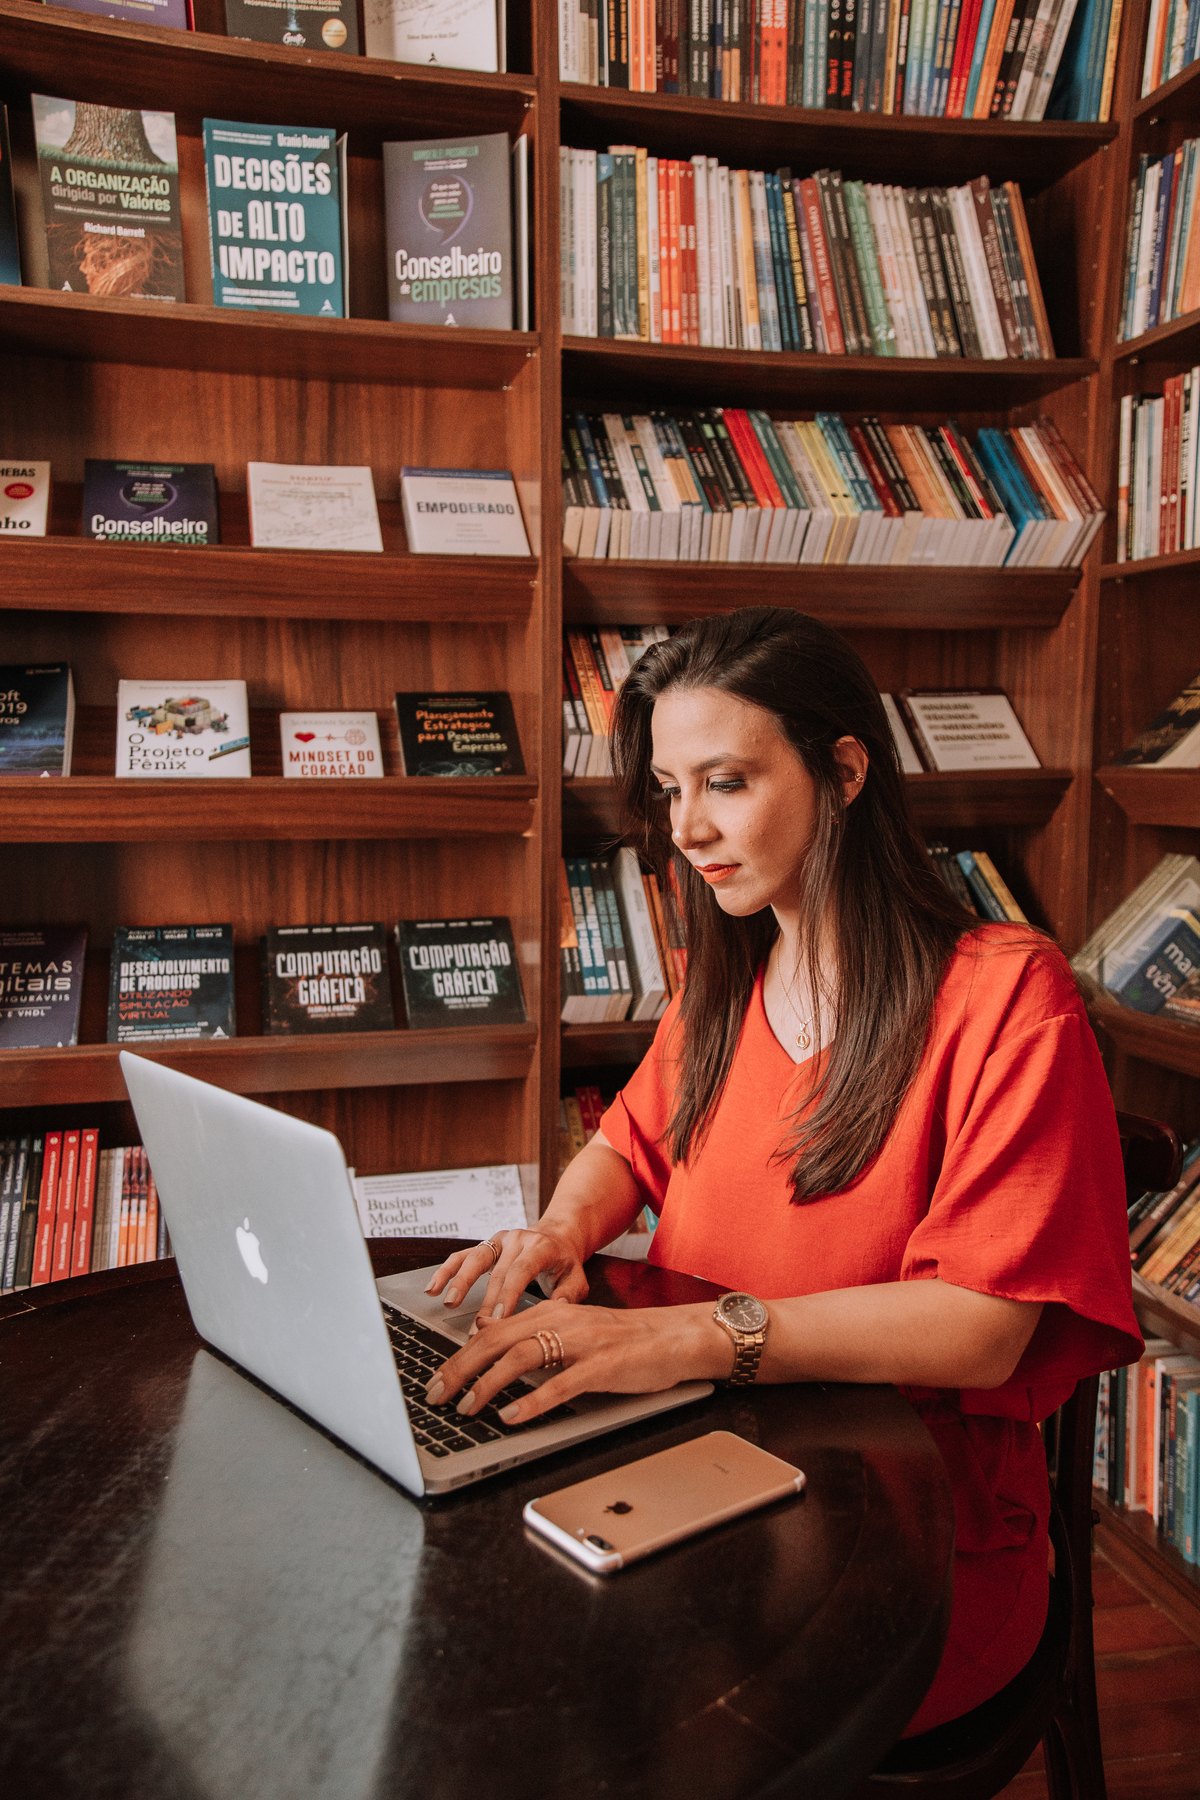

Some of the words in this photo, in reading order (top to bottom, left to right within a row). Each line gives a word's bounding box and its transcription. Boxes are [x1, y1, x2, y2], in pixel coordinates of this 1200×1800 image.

[828, 59, 839, 68] U
[842, 60, 853, 69] U
[827, 68, 839, 95] Teoria
[840, 70, 853, 97] Teoria
[50, 166, 63, 184] A
[66, 168, 170, 197] ORGANIZAÇÃO
[214, 153, 332, 195] DECISÕES
[52, 184, 95, 202] dirigida
[98, 192, 118, 205] por
[119, 192, 171, 212] Valores
[84, 222, 116, 236] Richard
[116, 226, 146, 238] Barrett
[217, 210, 245, 239] DE
[248, 200, 306, 243] ALTO
[808, 205, 829, 281] LIBERALISMO
[219, 244, 336, 285] IMPACTO
[395, 246, 502, 281] Conselheiro
[400, 282, 411, 295] de
[410, 275, 502, 309] empresas
[416, 501, 515, 515] EMPODERADO
[91, 514, 208, 536] Conselheiro
[415, 709, 495, 721] Planejamento
[128, 733, 145, 745] O
[417, 732, 446, 744] para
[446, 731, 501, 744] Pequenas
[128, 746, 204, 760] Projeto
[452, 741, 508, 754] Empresas
[128, 758, 187, 771] Fênix
[289, 750, 352, 763] MINDSET
[357, 750, 375, 762] DO
[301, 761, 366, 778] CORAÇÃO
[276, 946, 382, 979] COMPUTAÇÃO
[408, 940, 512, 970] COMPUTAÇÃO
[120, 958, 230, 977] DESENVOLVIMENTO
[120, 977, 136, 993] DE
[138, 974, 201, 991] PRODUTOS
[298, 976, 366, 1006] GRÁFICA
[432, 968, 499, 998] GRÁFICA
[119, 989, 193, 1001] UTILIZANDO
[18, 1009, 46, 1018] VHDL
[119, 999, 190, 1011] SIMULAÇÃO
[119, 1011, 170, 1021] VIRTUAL
[367, 1197, 435, 1212] Business
[369, 1209, 419, 1226] Model
[370, 1221, 460, 1237] Generation
[6, 1240, 18, 1278] FANTASMA
